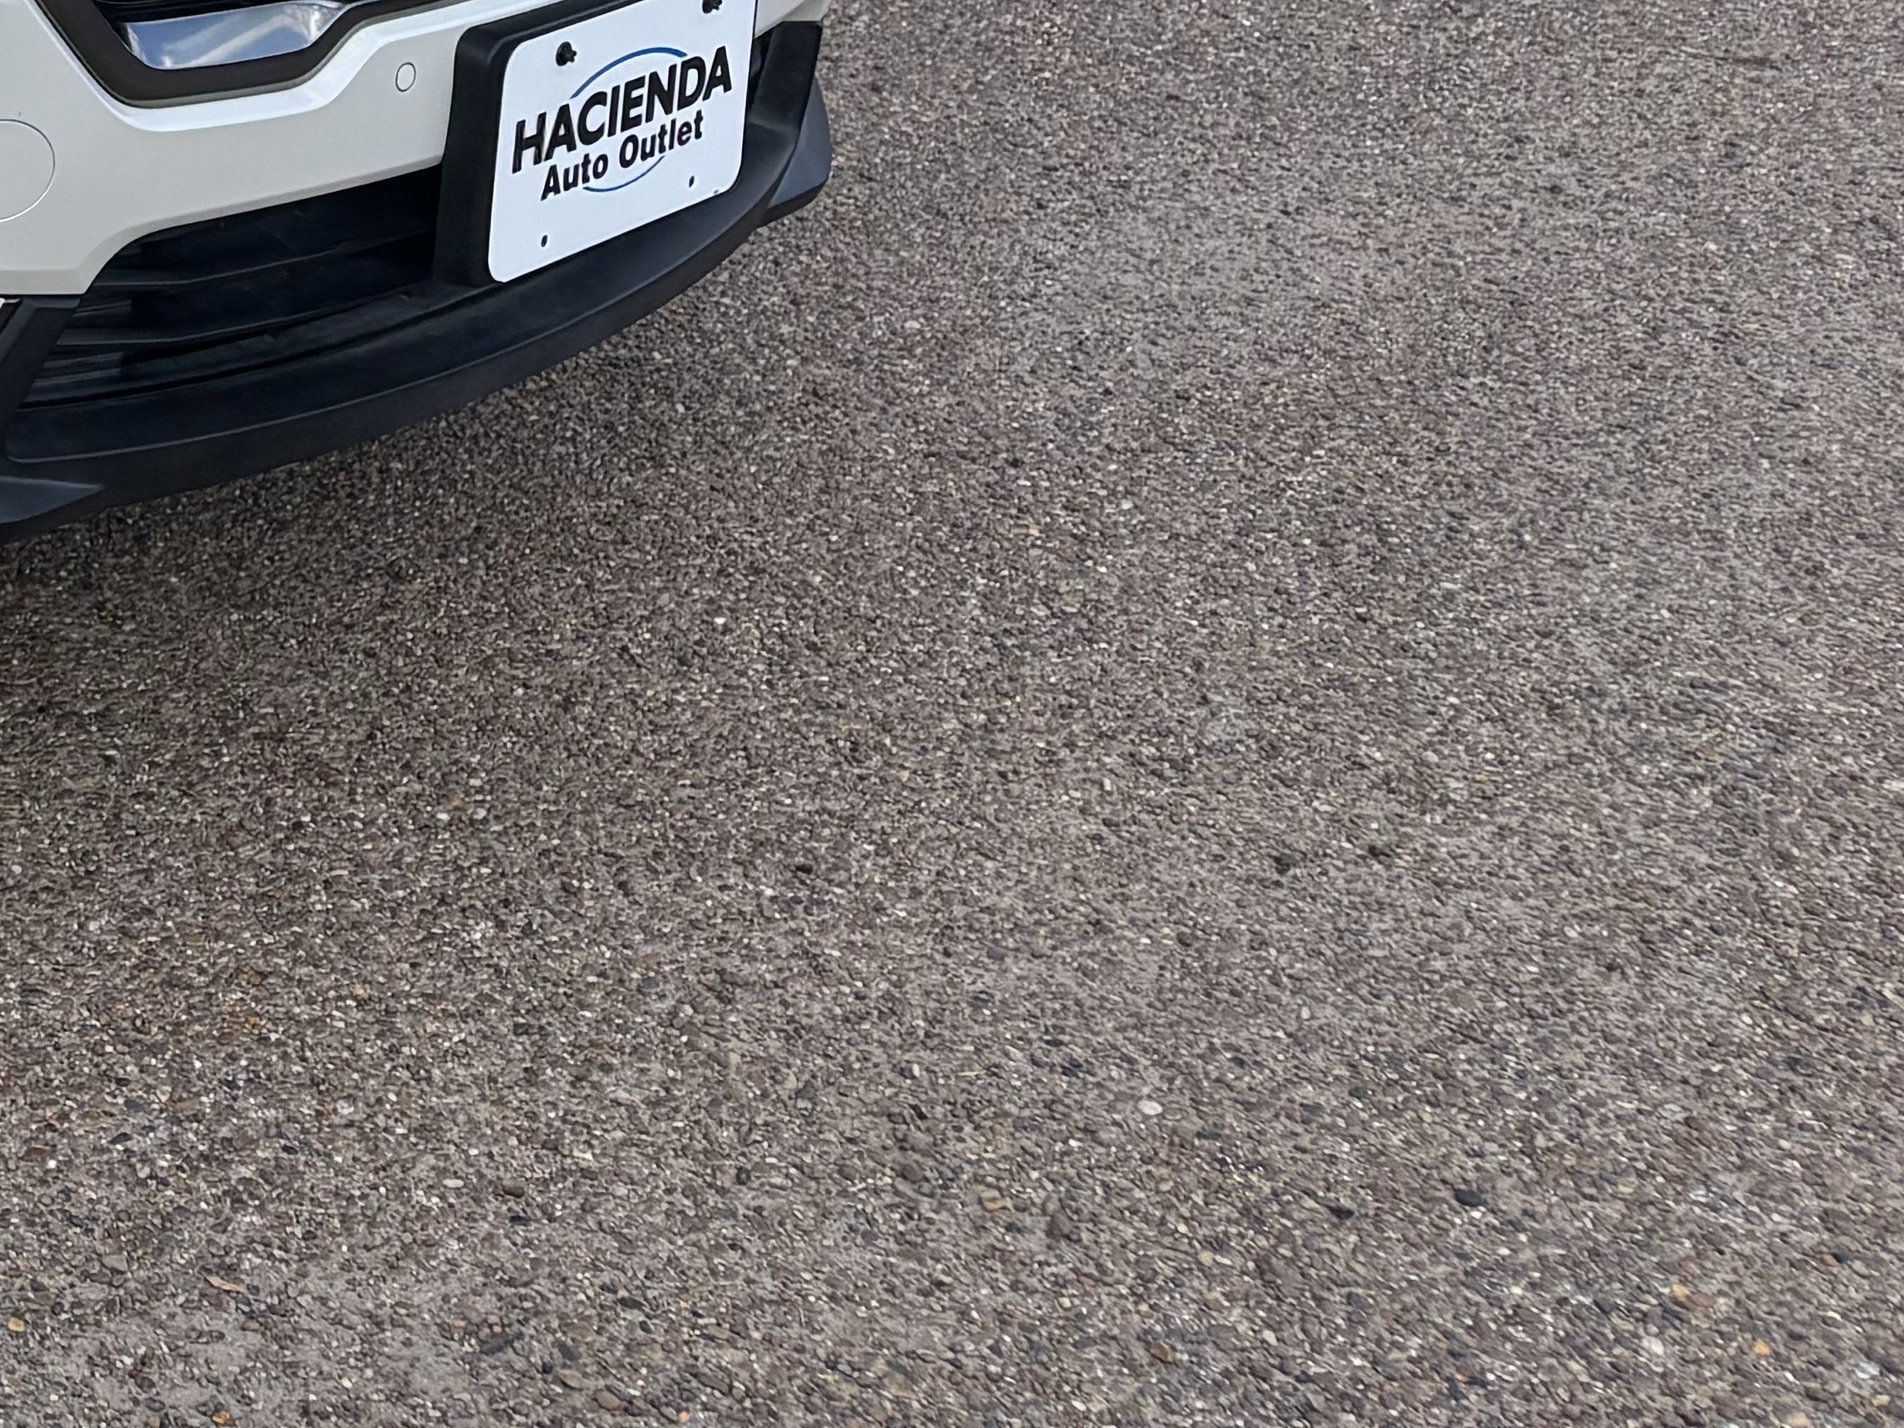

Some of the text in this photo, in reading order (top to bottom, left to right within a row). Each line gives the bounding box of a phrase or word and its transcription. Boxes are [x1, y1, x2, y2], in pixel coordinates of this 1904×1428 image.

[511, 45, 733, 174] HACIENDA
[540, 109, 704, 202] Auto Outlet
